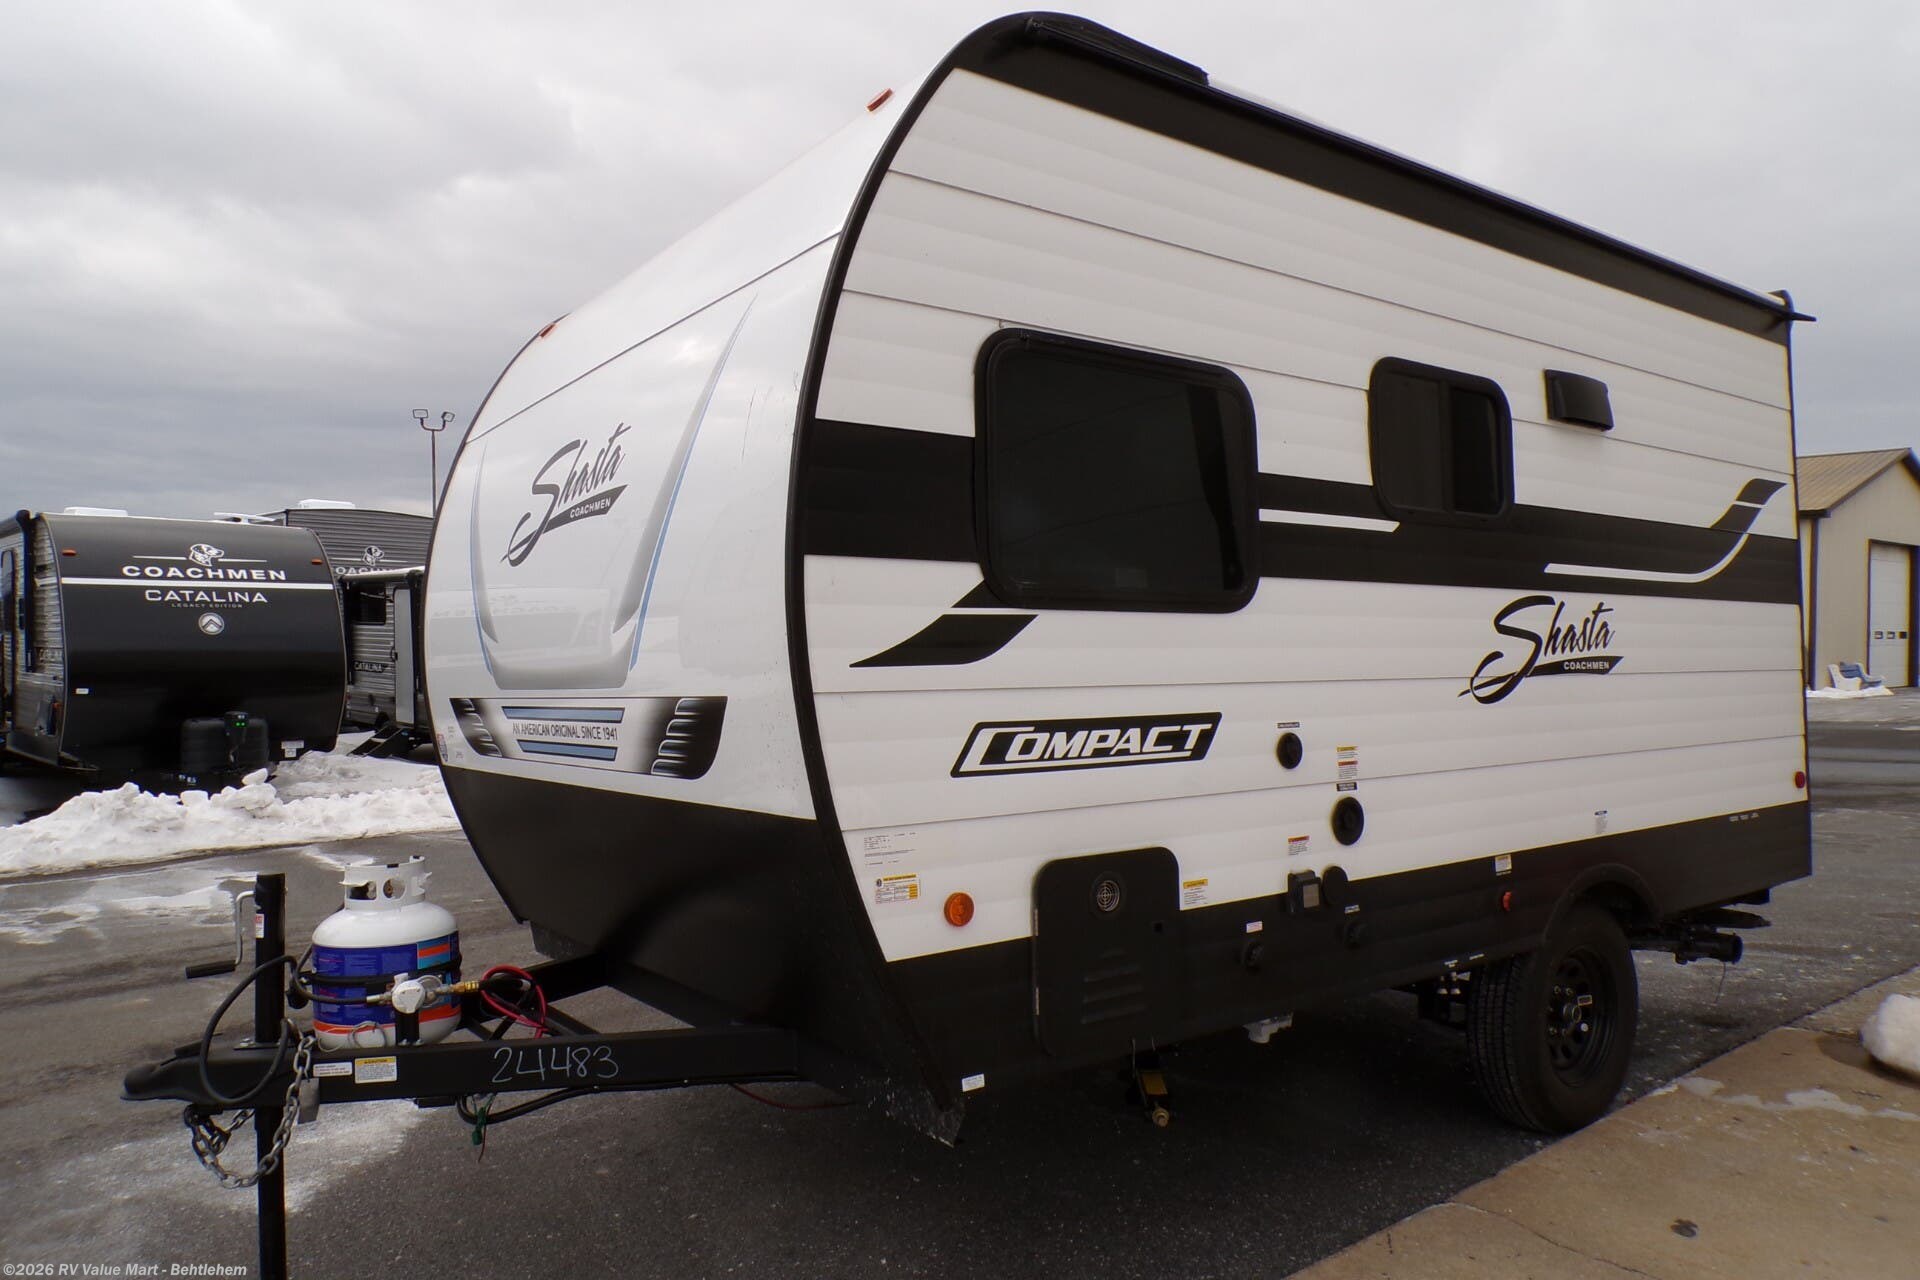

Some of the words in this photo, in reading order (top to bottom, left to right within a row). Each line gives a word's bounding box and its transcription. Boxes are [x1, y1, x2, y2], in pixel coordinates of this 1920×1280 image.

[502, 422, 631, 567] Shasta
[569, 499, 611, 519] COACHMEN
[122, 565, 287, 580] COACHMEN
[144, 589, 268, 603] CATALINA
[1467, 595, 1615, 704] Shasta
[1563, 660, 1610, 671] COACHMEN
[521, 722, 550, 737] AMERICAN
[550, 724, 581, 739] ORIGINAL
[582, 725, 601, 740] SINCE
[602, 727, 618, 741] 1941
[959, 724, 1213, 773] COMPACT
[492, 1046, 619, 1084] 24483
